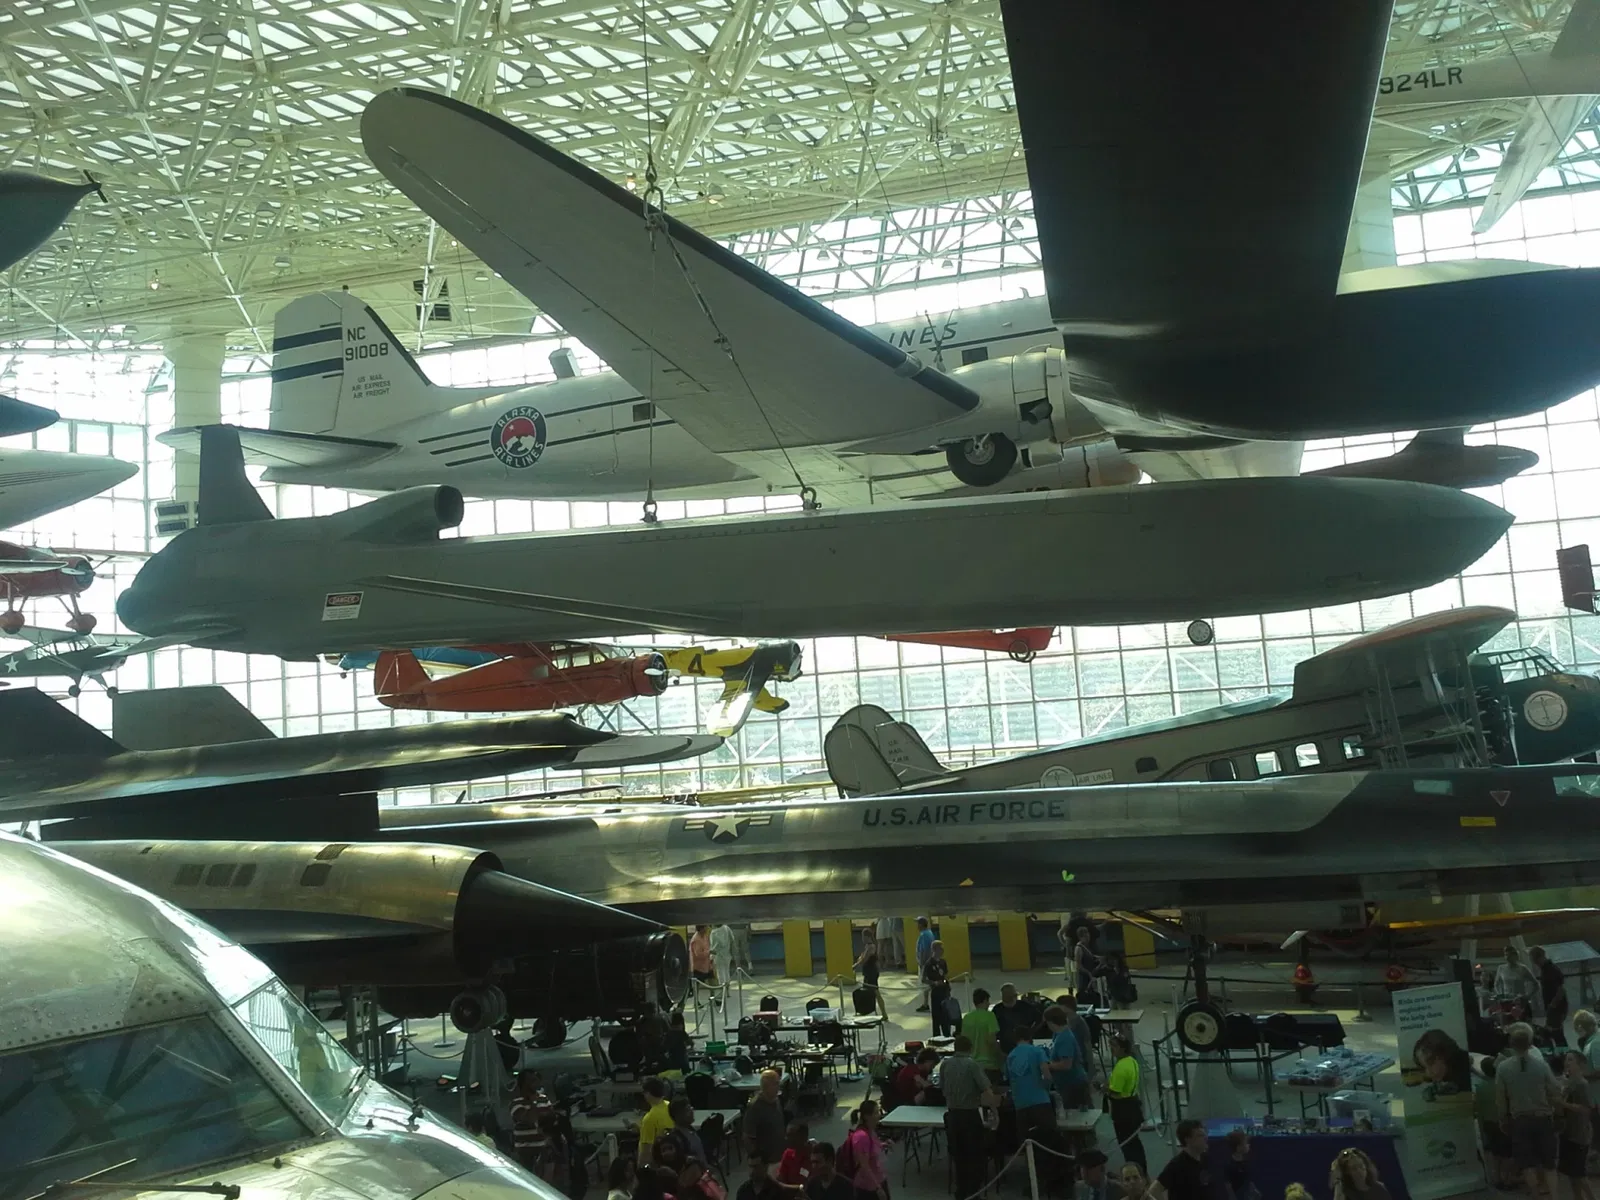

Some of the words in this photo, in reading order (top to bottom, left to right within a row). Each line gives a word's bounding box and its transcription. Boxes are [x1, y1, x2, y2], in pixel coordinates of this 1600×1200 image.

[1380, 67, 1463, 94] 924LR
[347, 327, 366, 341] NC
[345, 343, 388, 361] 91008
[364, 380, 391, 389] EXPRESS
[366, 388, 390, 396] FREIGHT
[498, 407, 540, 427] ALASKA
[495, 441, 543, 467] AIRLINES
[688, 654, 705, 676] 4
[969, 800, 1065, 821] FORCE
